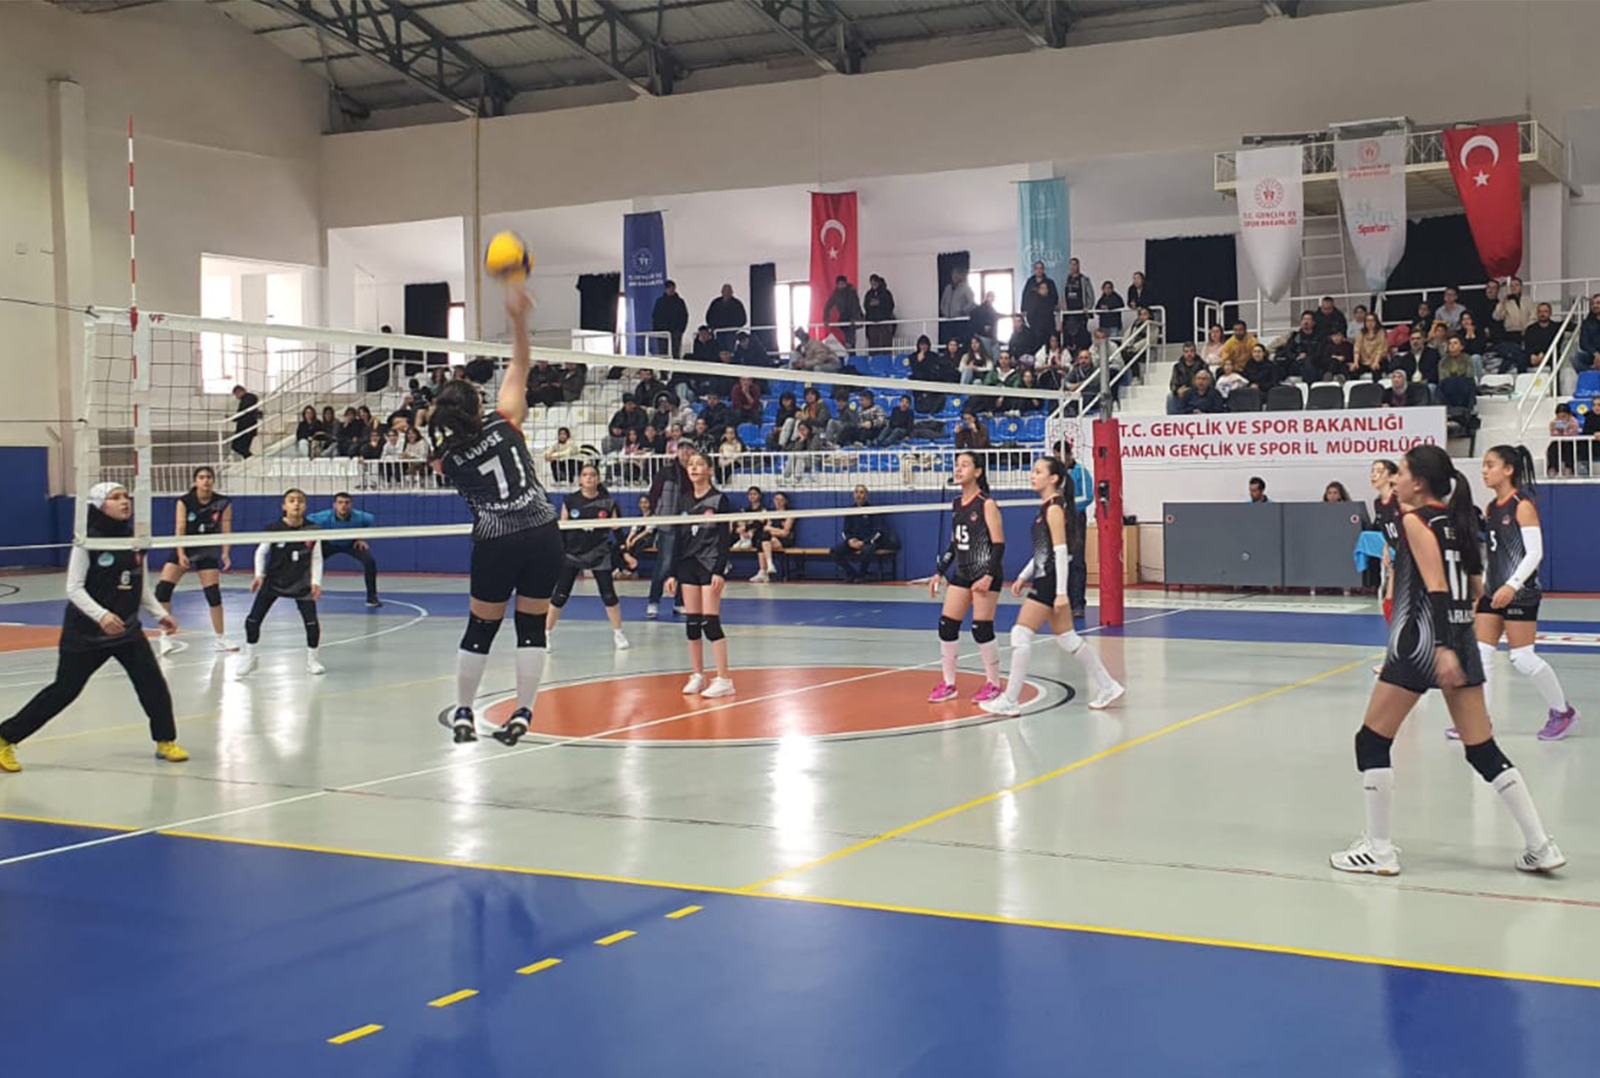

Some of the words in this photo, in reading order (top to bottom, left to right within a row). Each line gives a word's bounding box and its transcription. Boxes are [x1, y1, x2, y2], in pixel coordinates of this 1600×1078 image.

[1119, 423, 1147, 437] T.C.
[1150, 418, 1222, 439] GENÇLİK
[1226, 420, 1247, 434] VE
[1252, 419, 1298, 434] SPOR
[1303, 413, 1404, 433] BAKANLIĞI
[1120, 444, 1166, 458] AMAN
[1169, 440, 1233, 459] GENÇLİK
[1236, 443, 1256, 456] VE
[1260, 441, 1301, 455] SPOR
[1305, 437, 1319, 454] İL
[955, 524, 970, 543] 45
